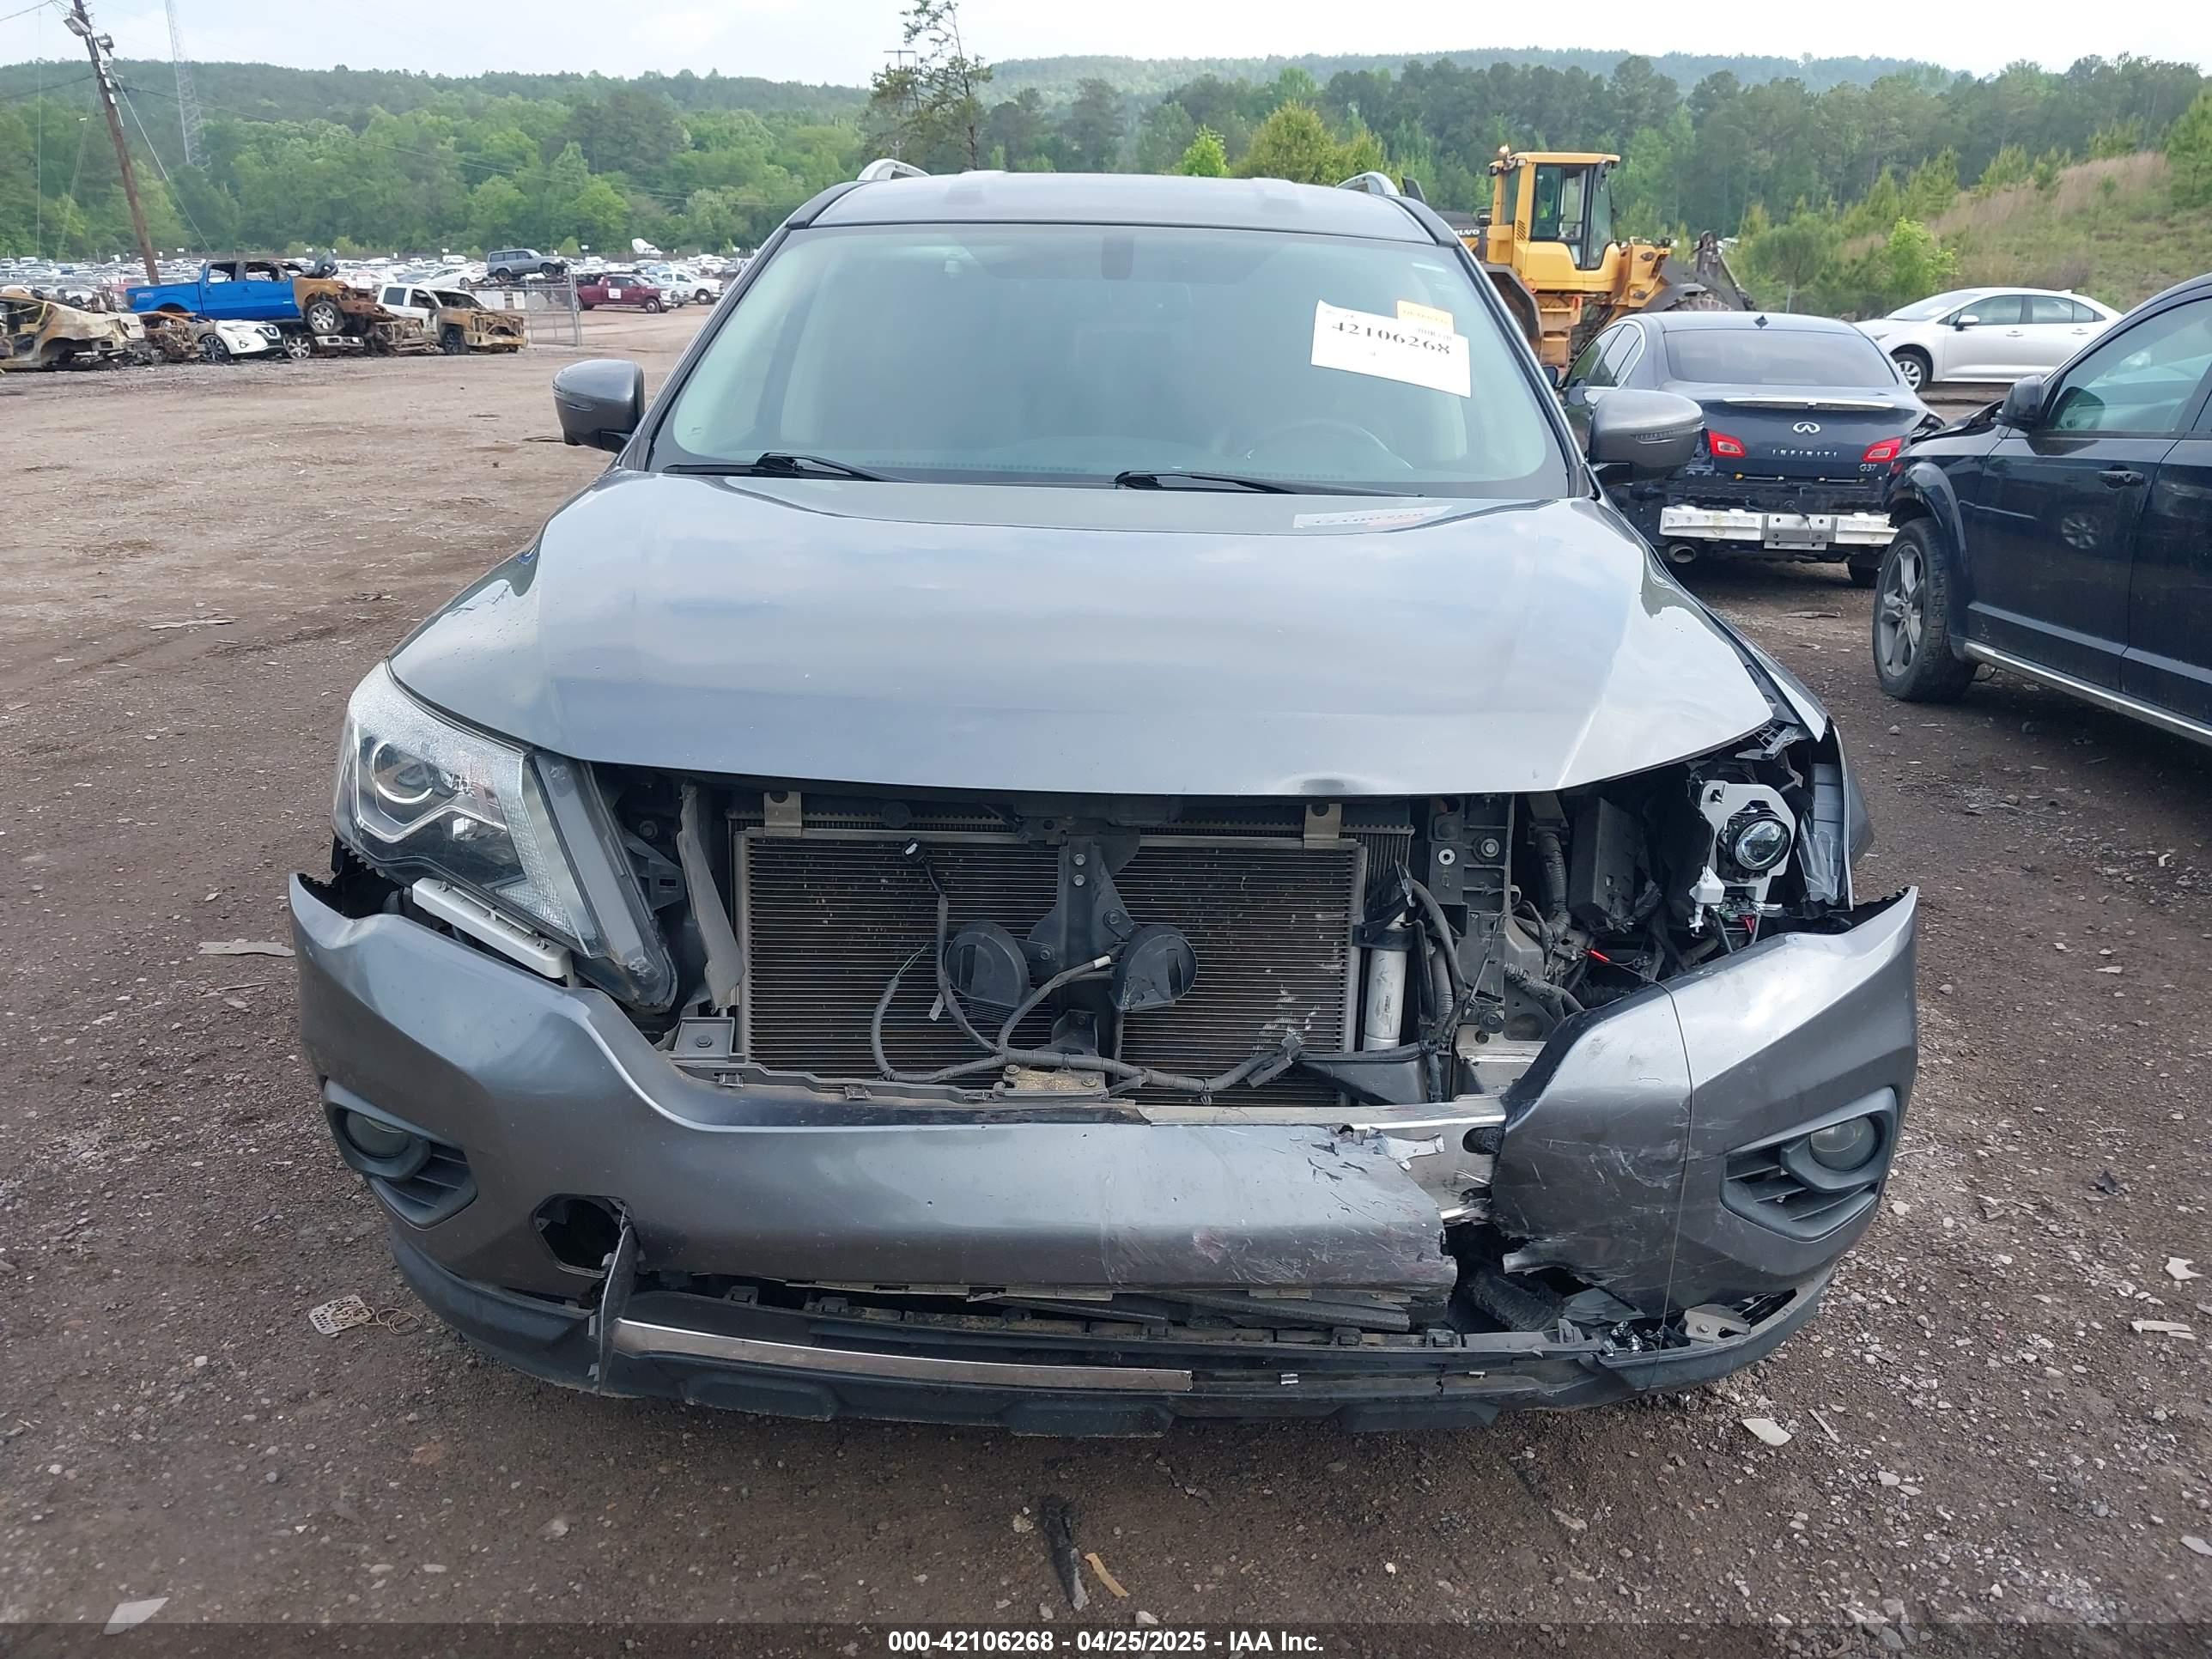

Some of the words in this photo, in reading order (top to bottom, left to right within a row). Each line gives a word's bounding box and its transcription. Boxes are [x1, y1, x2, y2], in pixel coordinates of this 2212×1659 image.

[1332, 322, 1450, 355] 42106268
[1772, 449, 1838, 458] INFINITI
[1859, 464, 1878, 472] G37
